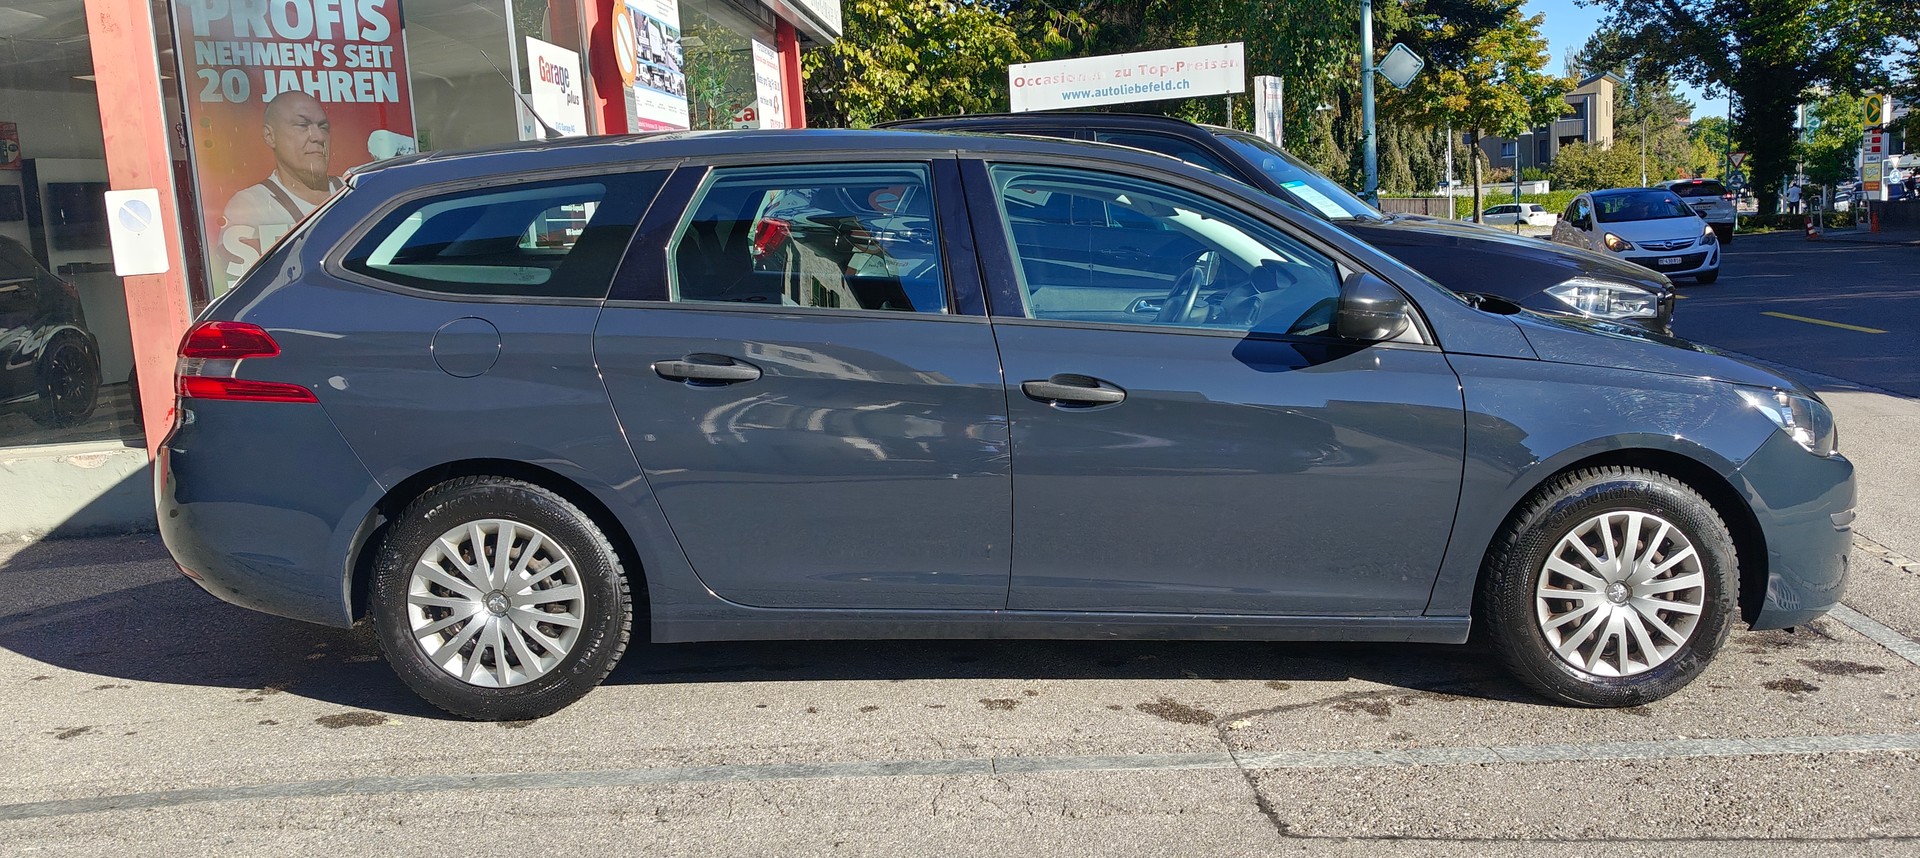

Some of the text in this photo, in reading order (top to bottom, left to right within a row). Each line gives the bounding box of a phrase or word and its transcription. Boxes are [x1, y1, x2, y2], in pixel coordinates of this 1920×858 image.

[190, 0, 391, 42] PROFIS
[194, 40, 394, 68] NEHMEN'S SEIT
[196, 68, 399, 103] 20 JAHREN
[538, 55, 570, 93] Garage
[1114, 68, 1132, 78] zu
[567, 90, 580, 106] plus
[1062, 79, 1190, 100] www.autoliebefeld.ch
